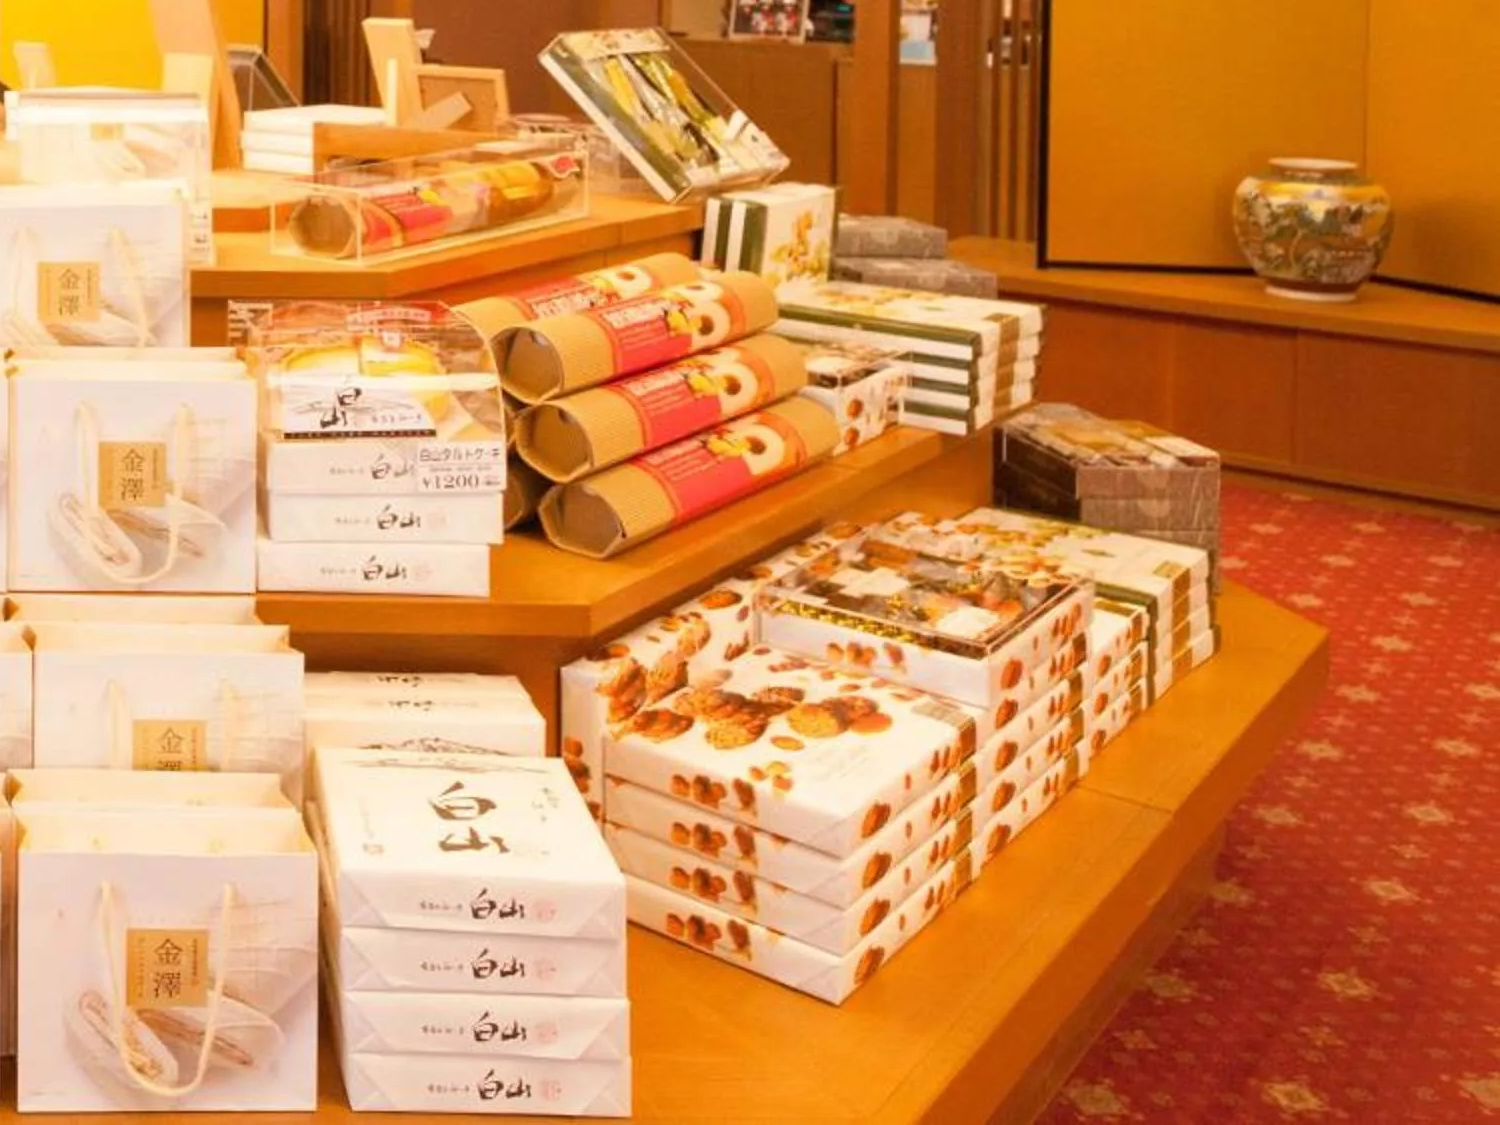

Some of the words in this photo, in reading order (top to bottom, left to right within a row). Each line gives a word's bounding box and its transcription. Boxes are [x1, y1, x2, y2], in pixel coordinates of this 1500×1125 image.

[376, 504, 422, 530] 白山
[362, 555, 408, 581] 白山
[428, 780, 511, 854] 白山
[469, 887, 526, 920] 白山
[152, 937, 183, 999] 金澤
[470, 947, 527, 979] 白山
[472, 1010, 529, 1042] 白山
[477, 1068, 533, 1101] 白山
